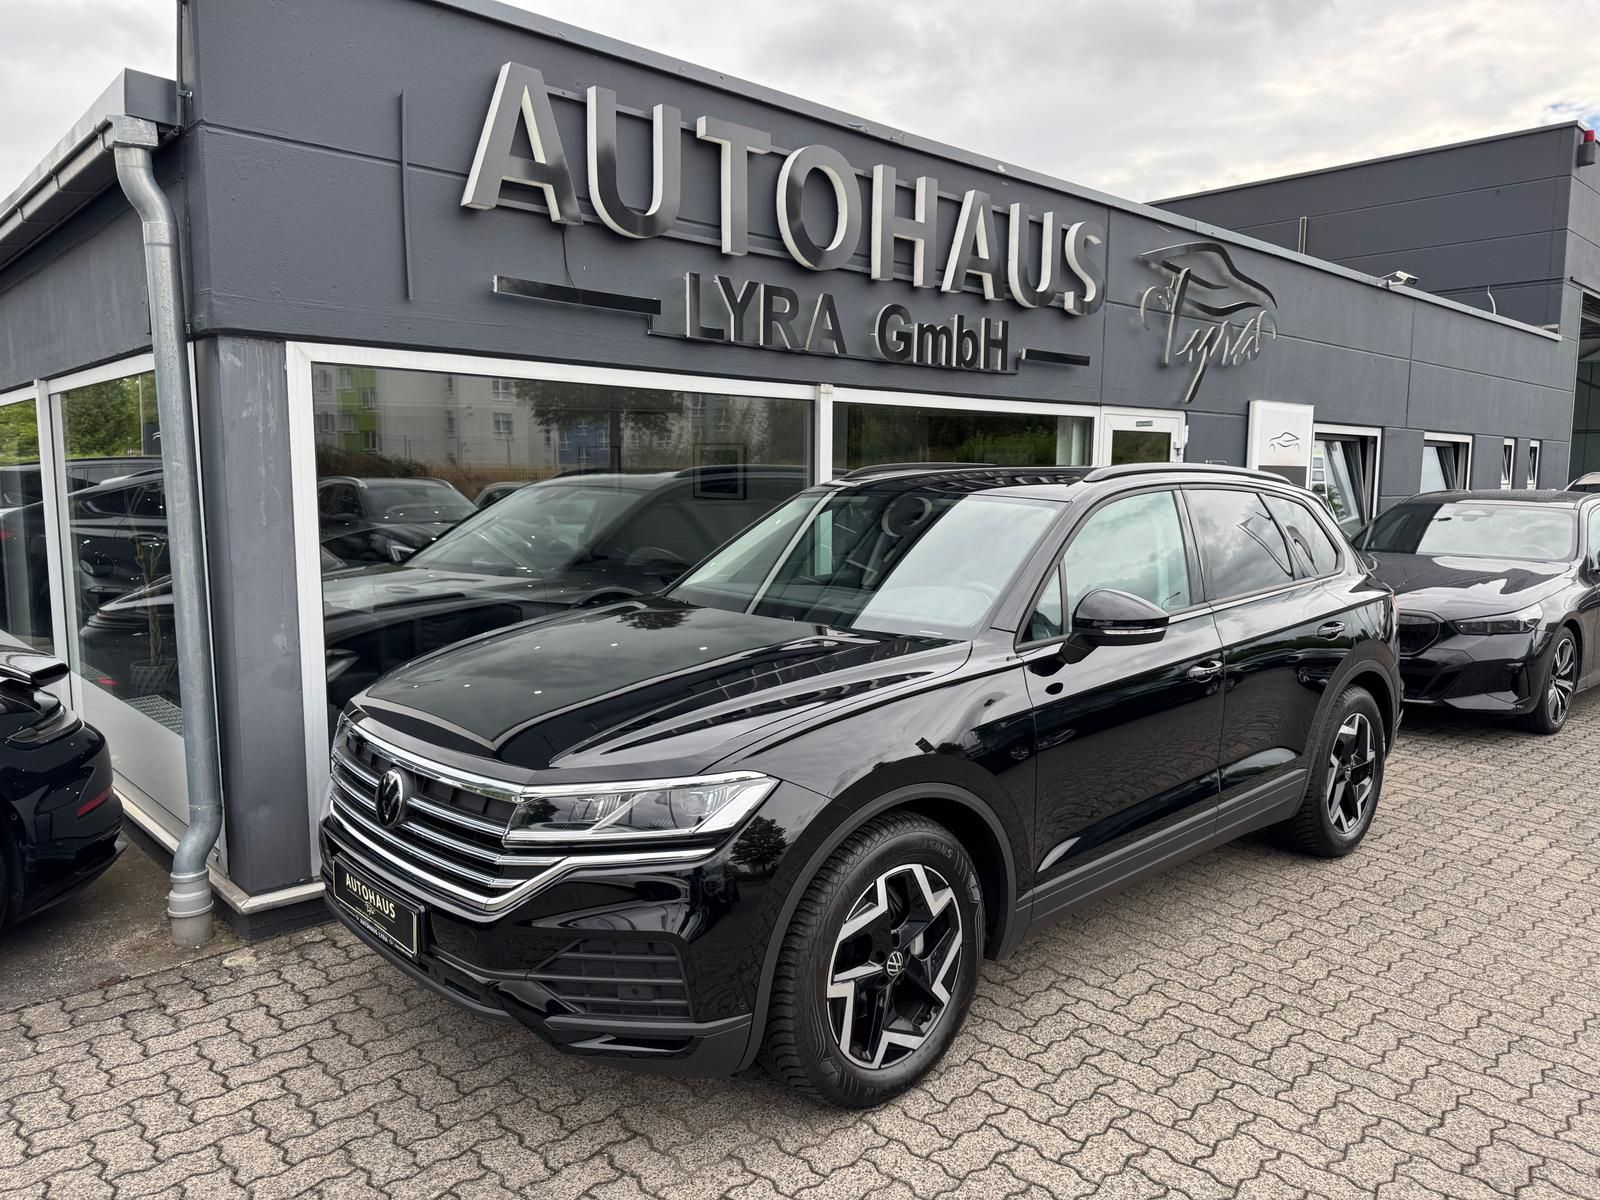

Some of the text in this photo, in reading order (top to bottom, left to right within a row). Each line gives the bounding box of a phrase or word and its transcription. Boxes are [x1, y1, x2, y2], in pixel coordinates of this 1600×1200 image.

[460, 61, 1106, 315] AUTOHAUS
[684, 271, 1010, 371] LYRA GmbH
[345, 872, 396, 919] AUTOHAUS
